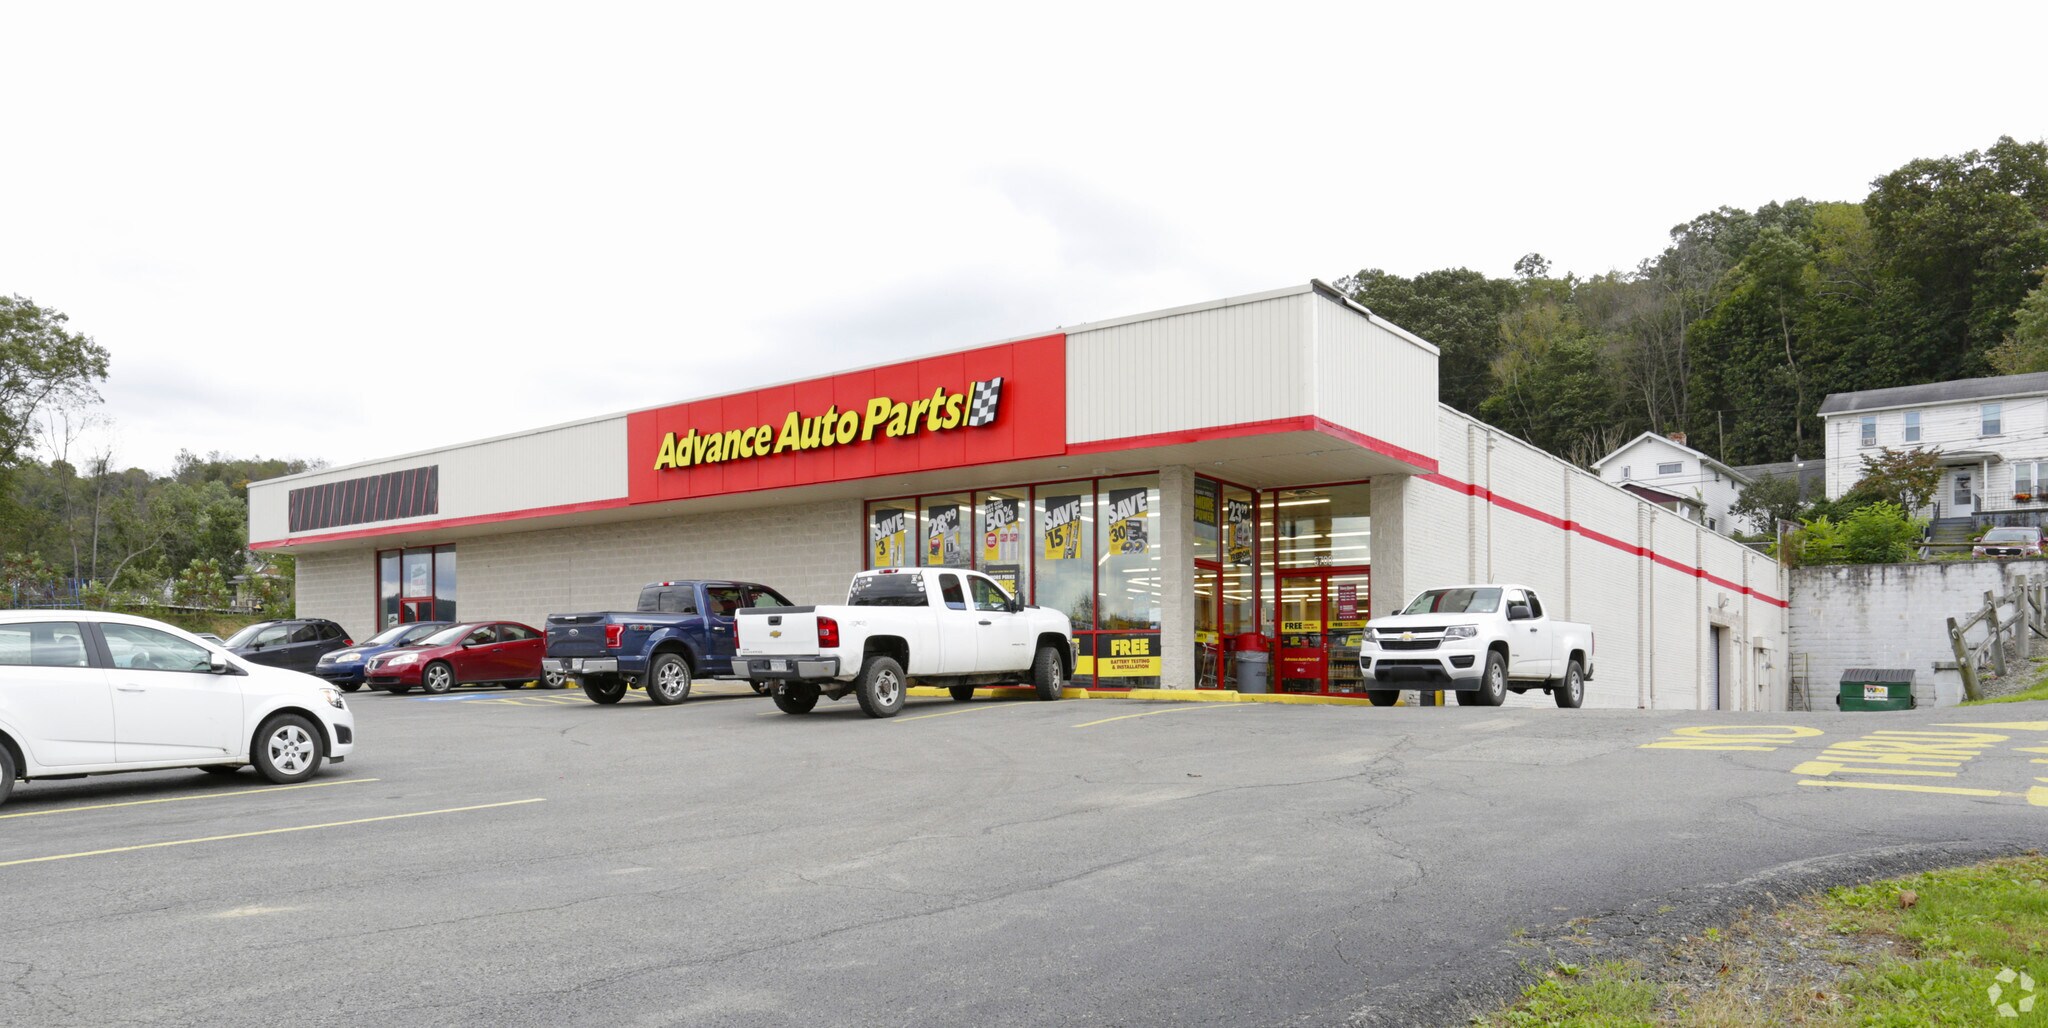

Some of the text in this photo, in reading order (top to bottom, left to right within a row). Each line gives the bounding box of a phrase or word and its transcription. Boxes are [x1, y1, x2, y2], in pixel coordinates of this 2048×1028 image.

[654, 386, 965, 470] Advance Auto Parts
[986, 504, 1014, 532] 50%
[1045, 500, 1080, 531] SAVE
[1108, 491, 1147, 524] SAVE
[875, 512, 905, 541] SAVE
[1285, 622, 1302, 630] FREE
[1111, 638, 1149, 656] FREE
[1636, 725, 1825, 752] NO
[1790, 730, 2011, 777] THRU
